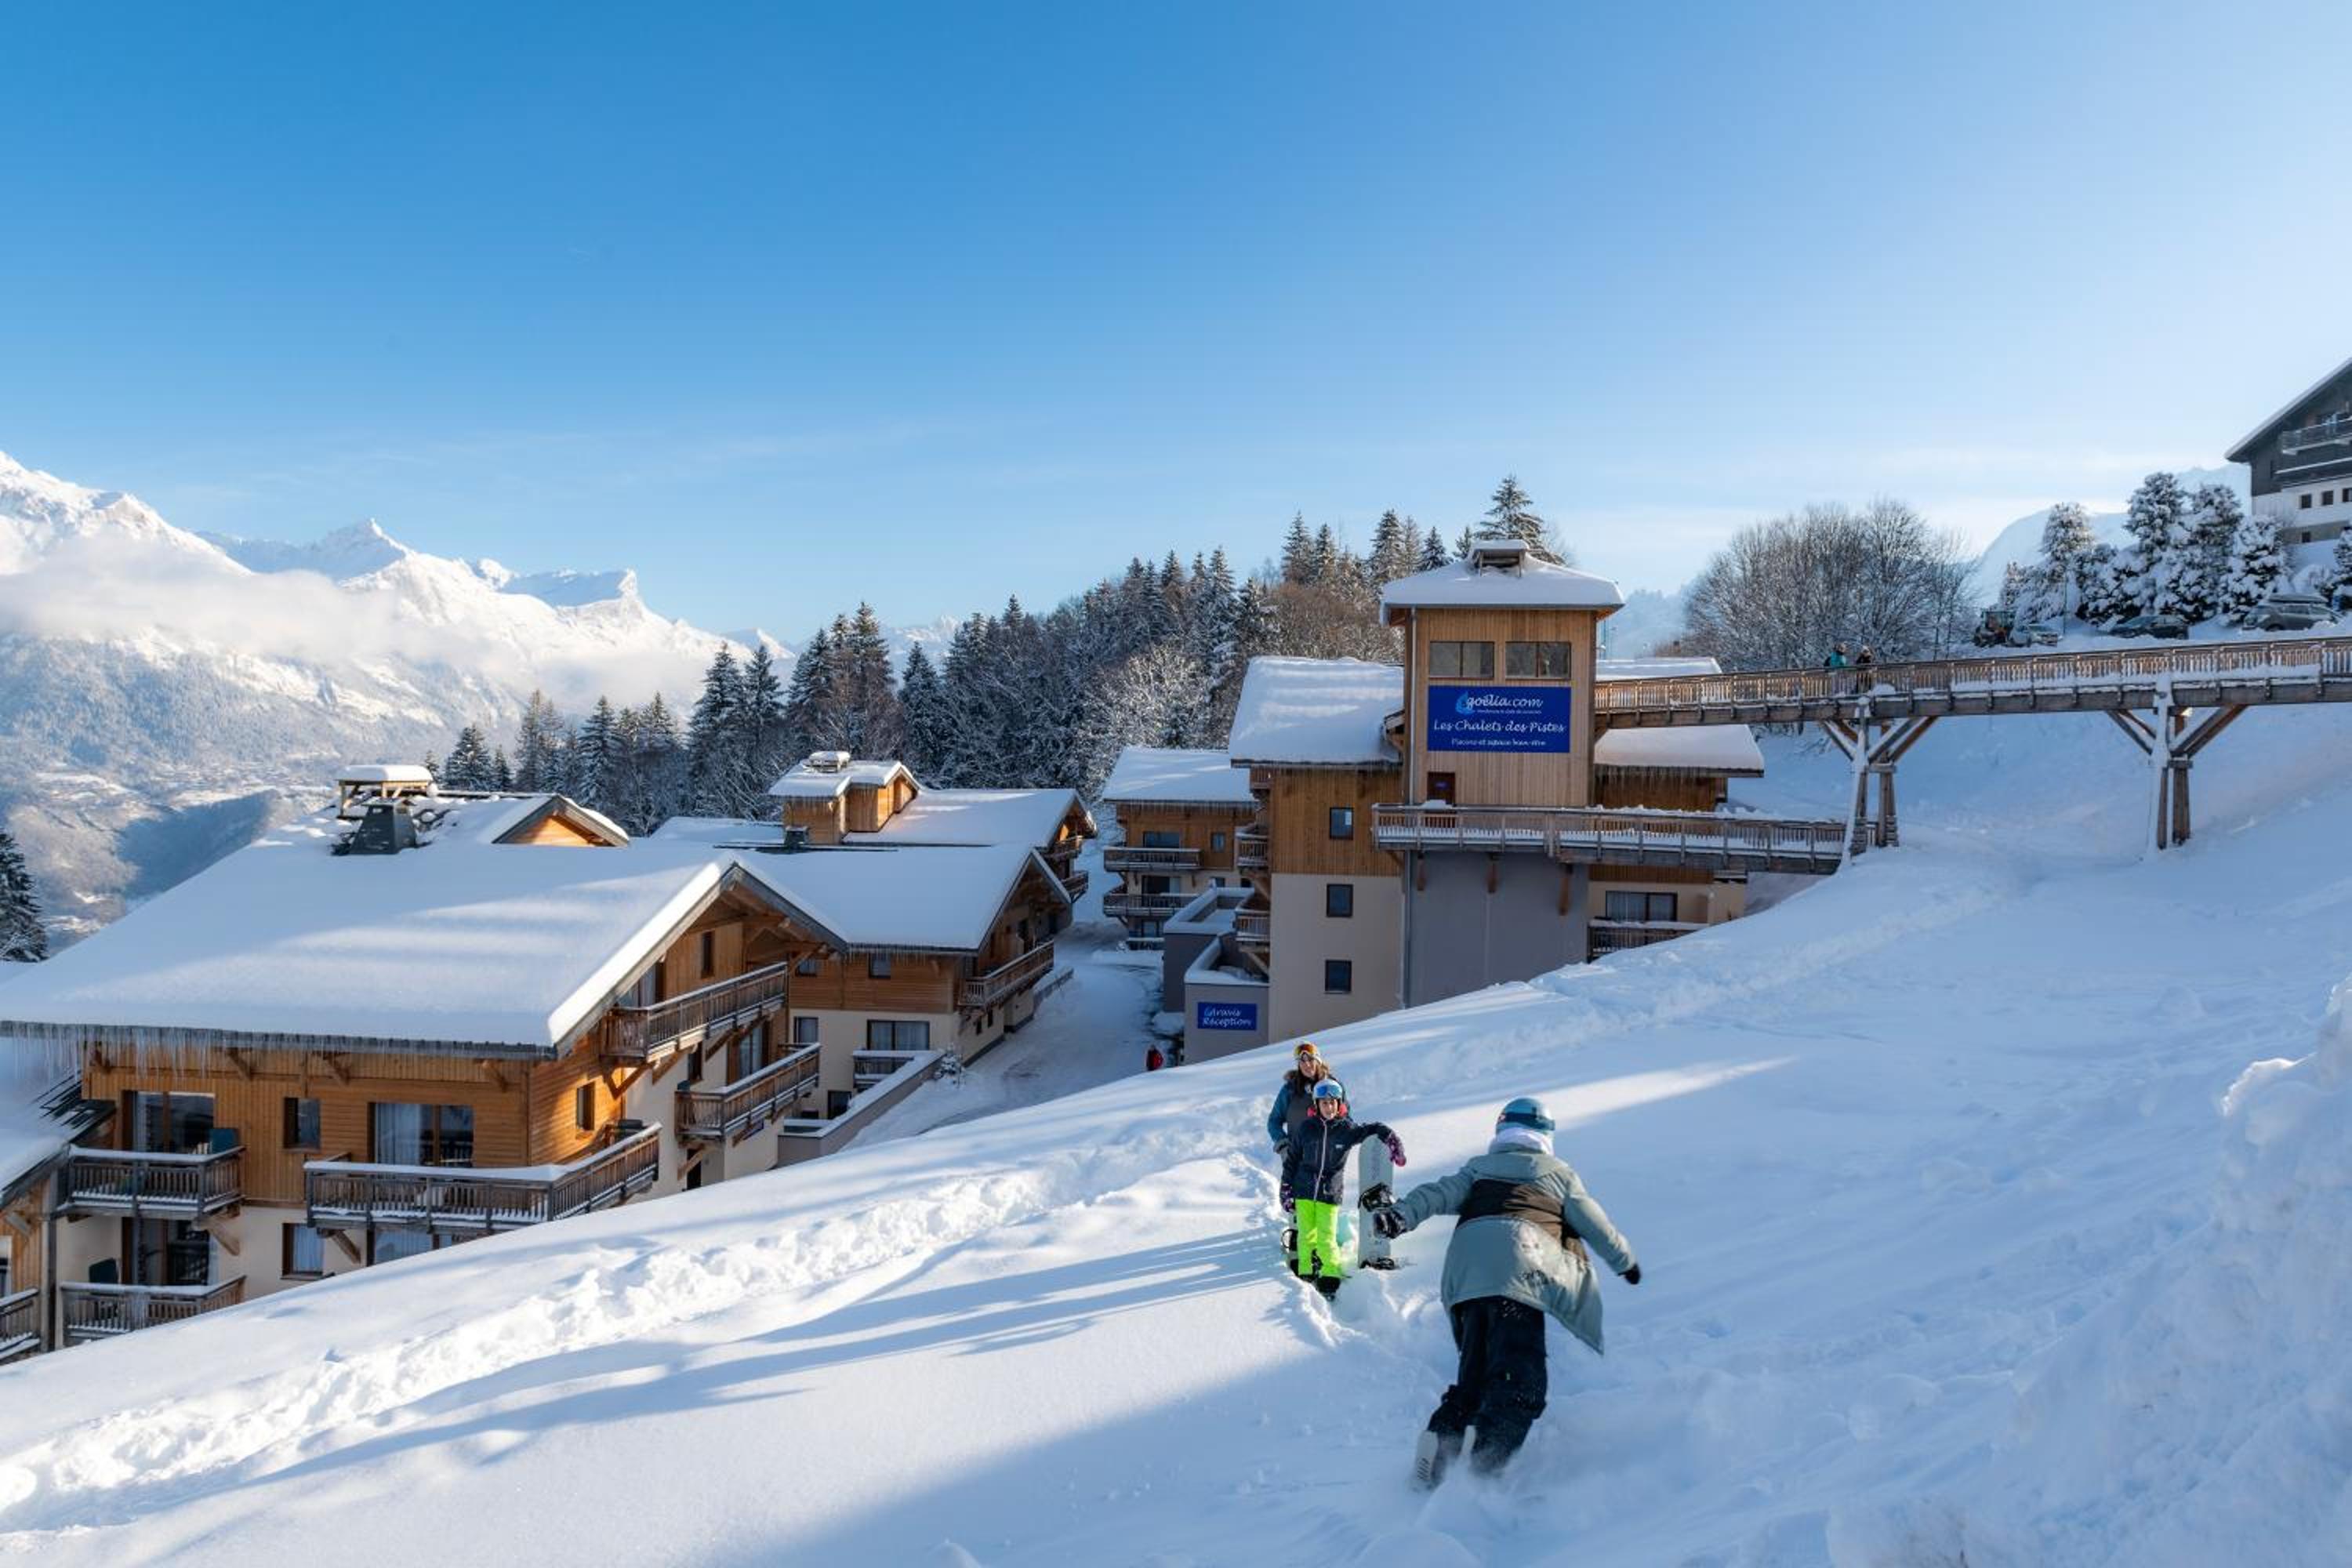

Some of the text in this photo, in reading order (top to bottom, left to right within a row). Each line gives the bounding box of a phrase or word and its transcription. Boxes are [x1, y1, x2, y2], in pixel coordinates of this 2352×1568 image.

[1433, 719, 1565, 733] Les Chalets des Pistes
